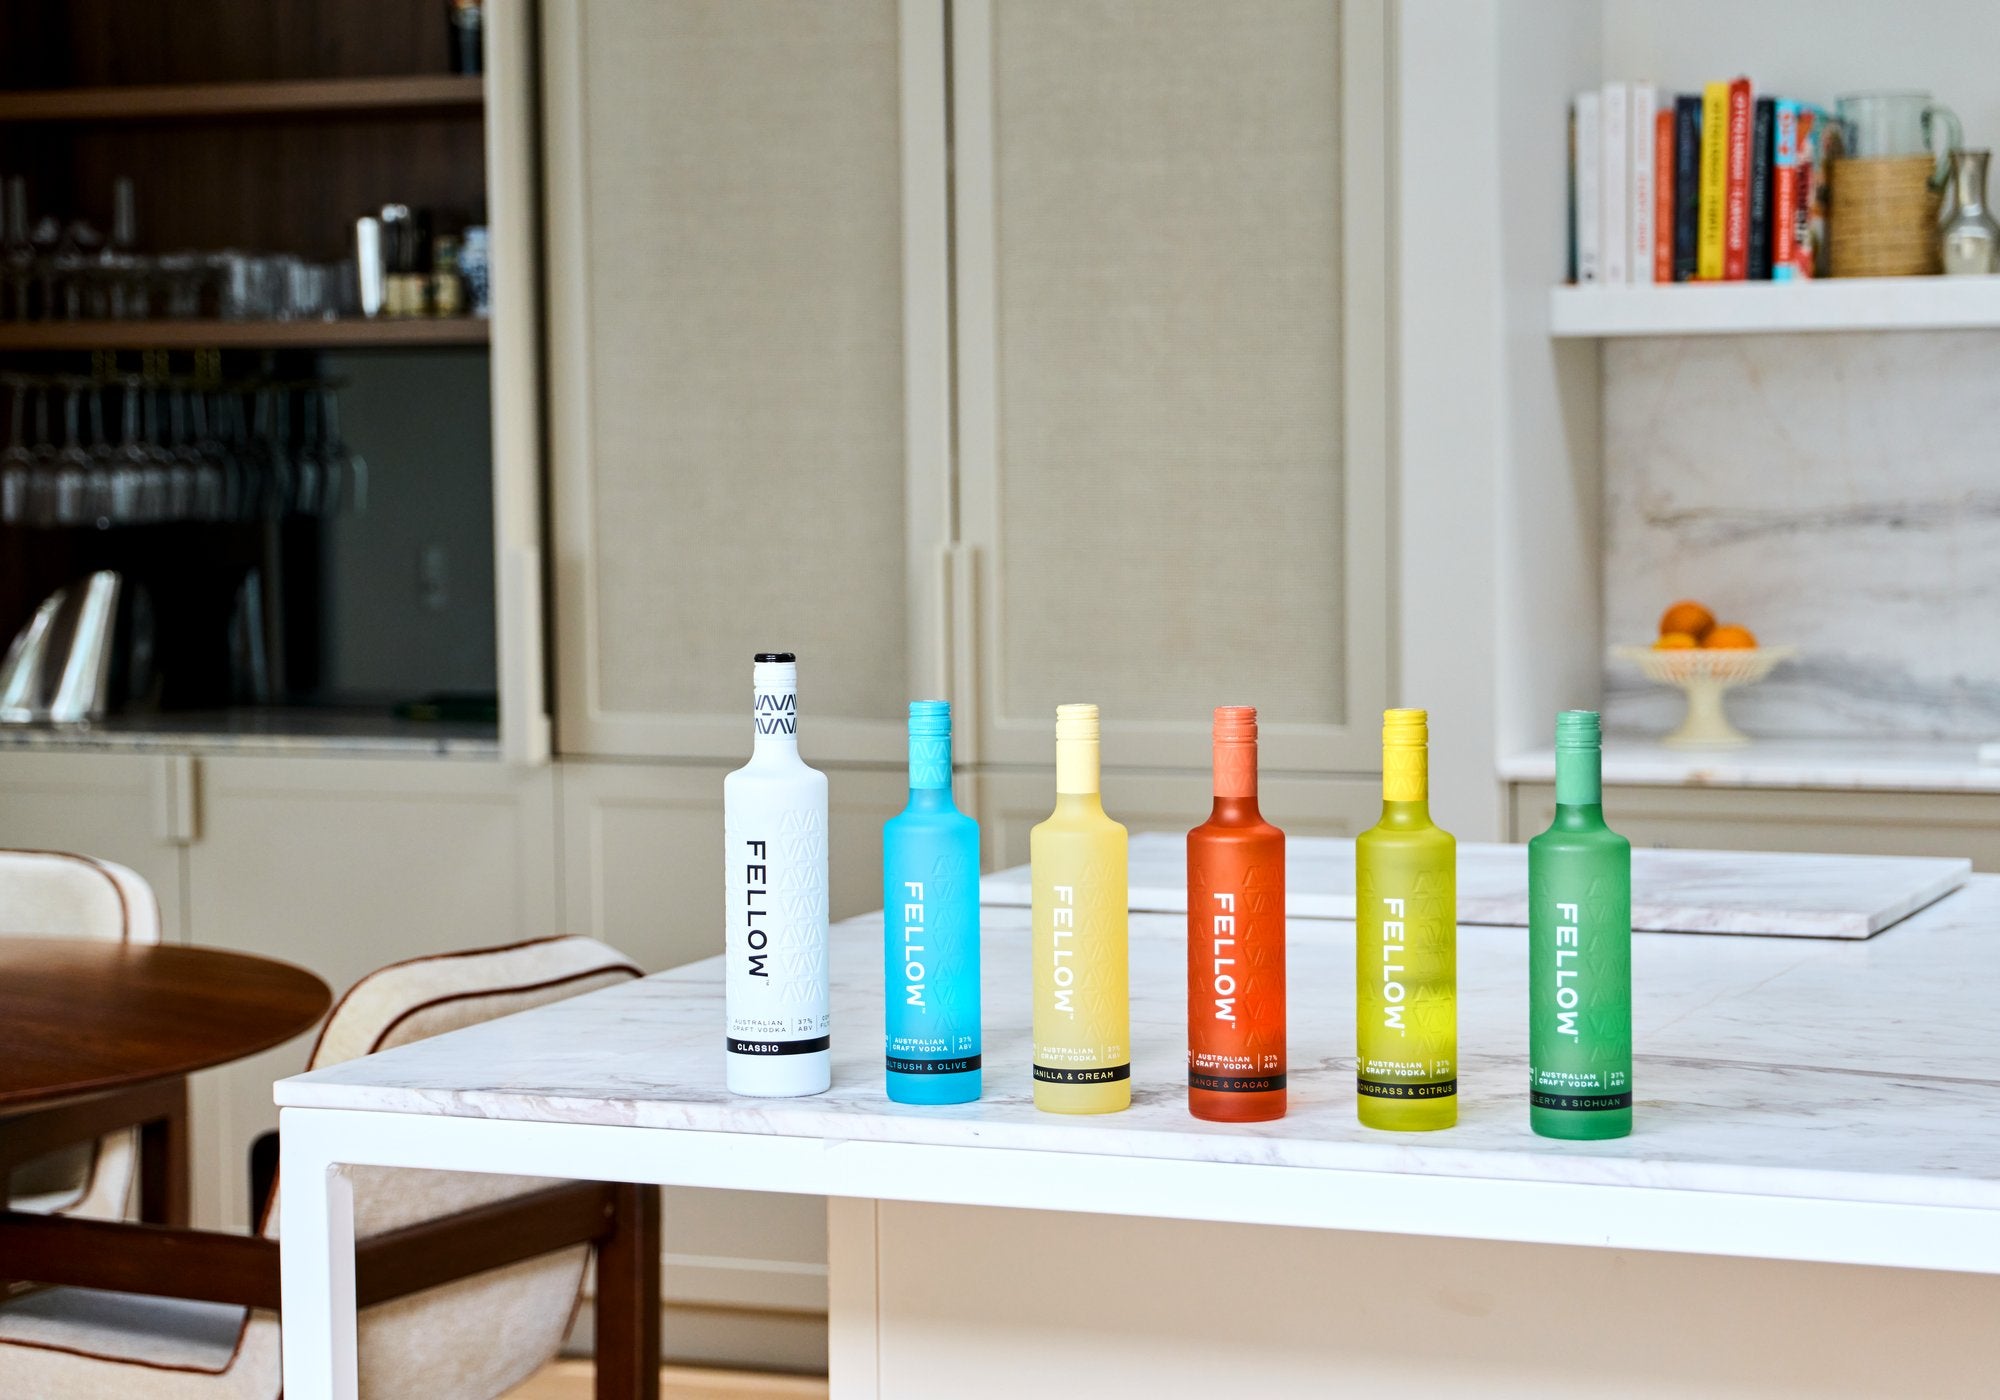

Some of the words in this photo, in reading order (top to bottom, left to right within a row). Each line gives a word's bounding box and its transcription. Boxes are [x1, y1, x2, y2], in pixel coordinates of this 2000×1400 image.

[747, 841, 769, 977] FELLOW
[904, 881, 926, 1007] FELLOW
[1053, 886, 1074, 1012] FELLOW
[1213, 893, 1236, 1021] FELLOW
[1383, 898, 1405, 1029] FELLOW
[1556, 903, 1579, 1036] FELLOW
[735, 1018, 783, 1026] AUSTRALIAN
[798, 1017, 813, 1025] 37%
[894, 1037, 945, 1045] AUSTRALIAN
[737, 1043, 779, 1052] CLASSIC
[892, 1044, 915, 1052] CRAFT
[1042, 1046, 1094, 1054] AUSTRALIAN
[1040, 1053, 1065, 1061] CRAFT
[1197, 1053, 1250, 1062] AUSTRALIAN
[927, 1063, 933, 1071] &
[937, 1061, 967, 1070] OLIVE
[1195, 1060, 1220, 1068] CRAFT
[1368, 1060, 1422, 1069] AUSTRALIAN
[1066, 1072, 1073, 1080] &
[1077, 1071, 1114, 1080] CREAM
[1366, 1067, 1392, 1076] CRAFT
[1541, 1070, 1596, 1080] AUSTRALIAN
[1610, 1071, 1624, 1079] 37%
[1233, 1081, 1269, 1089] CACAO
[1538, 1077, 1565, 1087] CRAFT
[1407, 1087, 1414, 1096] &
[1418, 1084, 1453, 1095] CITRUS
[1561, 1099, 1567, 1107] &
[1572, 1098, 1621, 1107] SICHUAN
